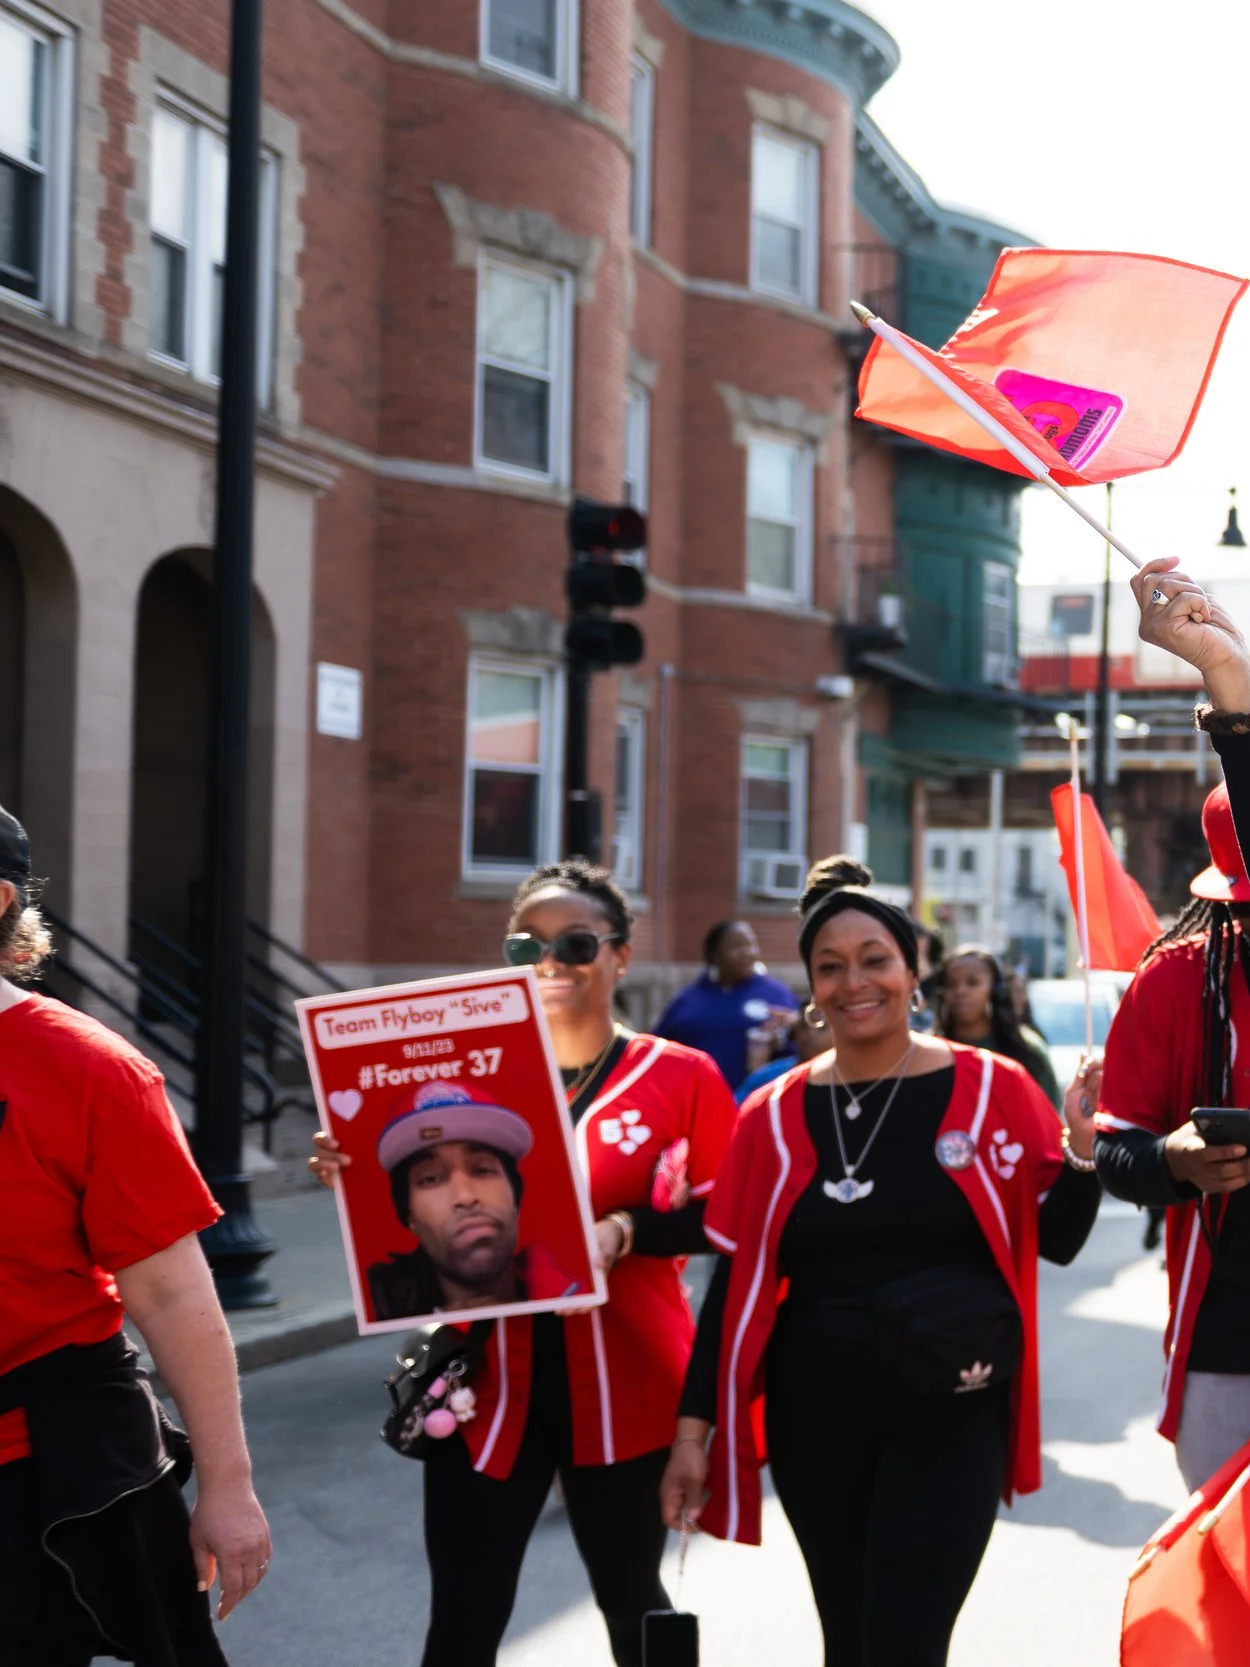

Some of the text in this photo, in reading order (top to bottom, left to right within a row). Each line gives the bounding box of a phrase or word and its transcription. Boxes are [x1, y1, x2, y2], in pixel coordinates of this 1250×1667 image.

[323, 1018, 377, 1037] Team
[381, 1004, 445, 1032] Flyboy
[358, 1047, 503, 1090] #Forever 37
